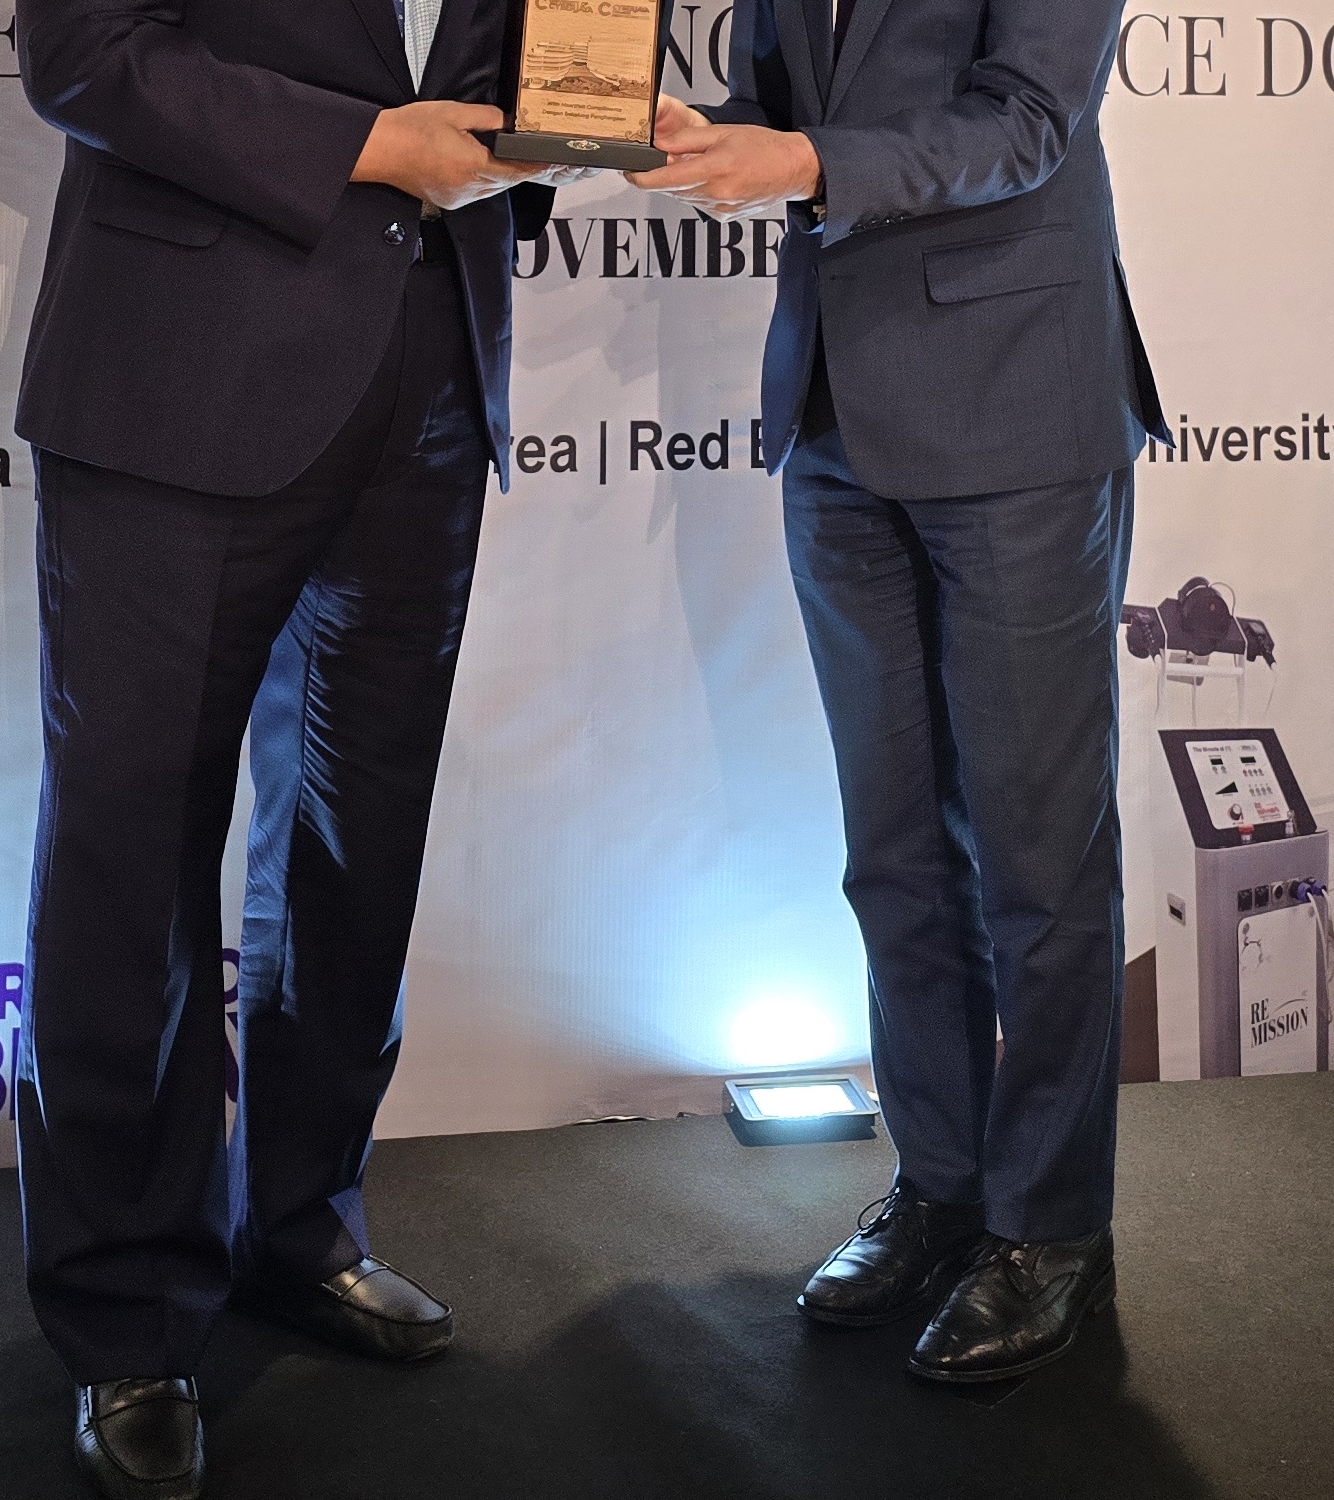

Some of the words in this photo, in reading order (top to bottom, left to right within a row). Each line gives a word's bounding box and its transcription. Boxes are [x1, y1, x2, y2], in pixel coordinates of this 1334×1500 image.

[629, 418, 730, 472] Red
[1250, 997, 1270, 1025] RE
[1250, 1006, 1309, 1050] MISSION
